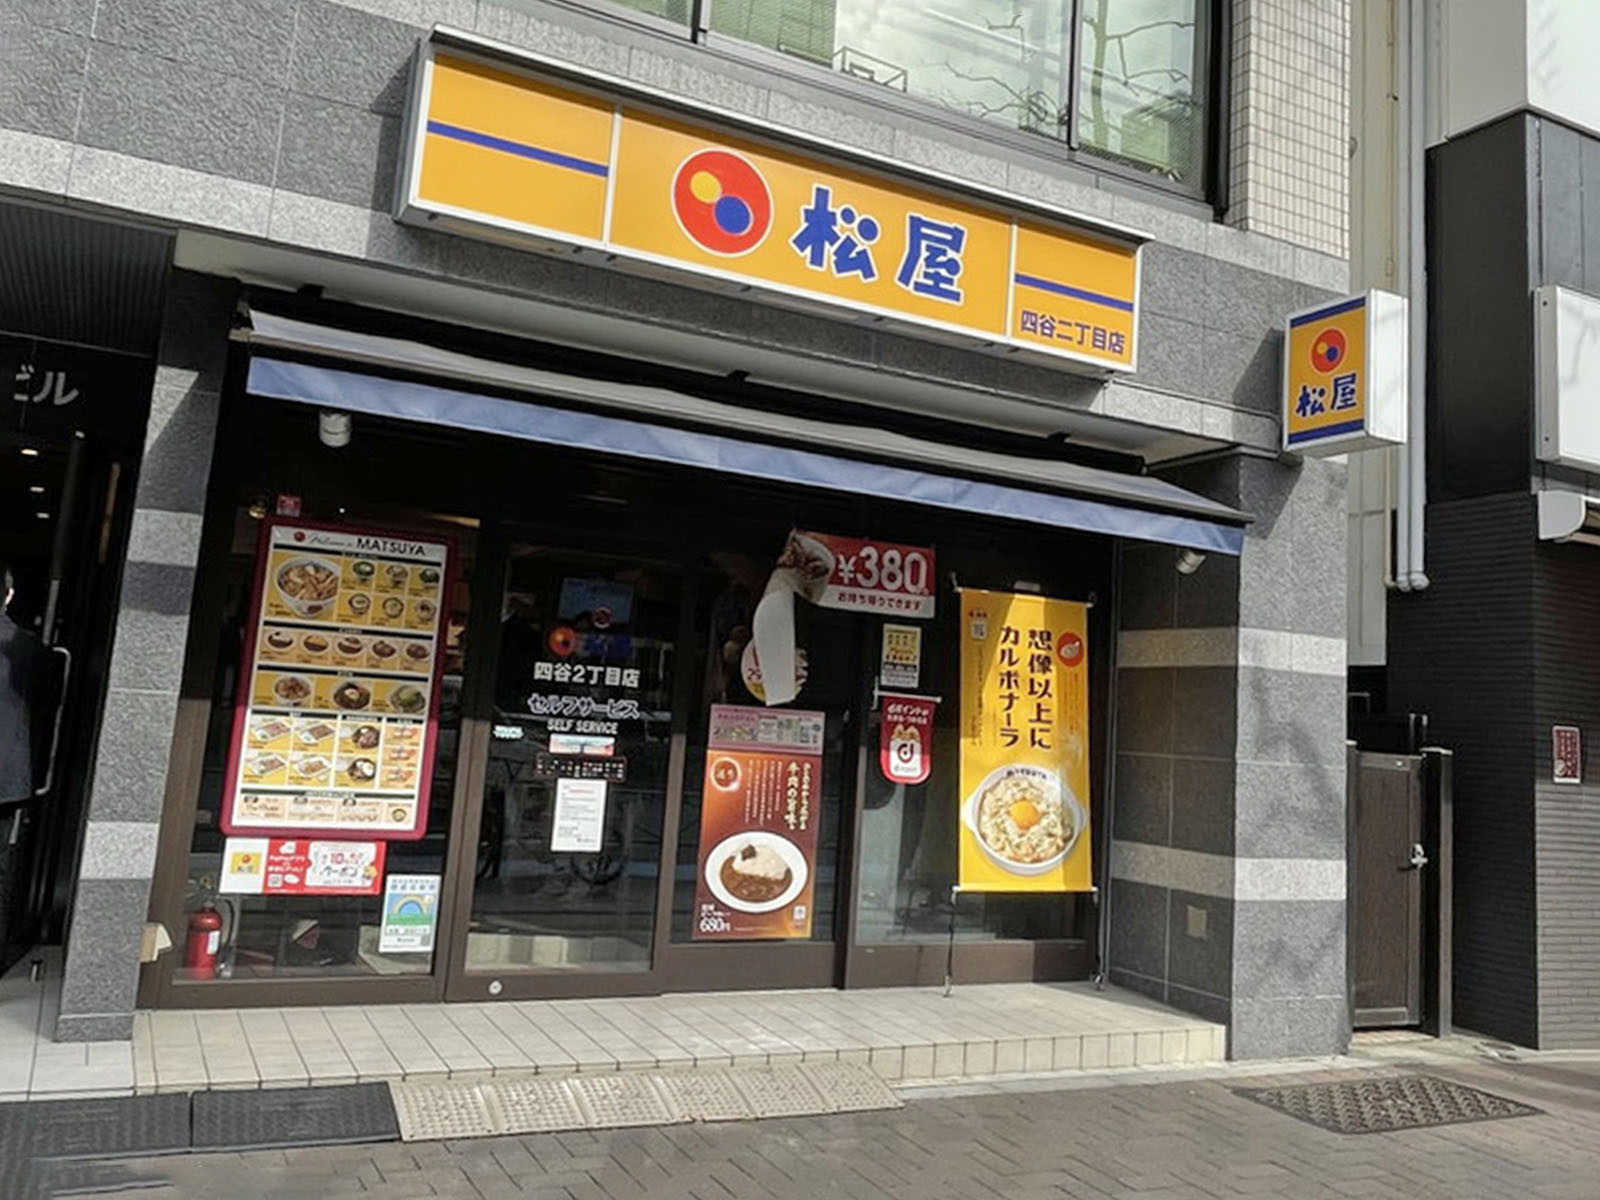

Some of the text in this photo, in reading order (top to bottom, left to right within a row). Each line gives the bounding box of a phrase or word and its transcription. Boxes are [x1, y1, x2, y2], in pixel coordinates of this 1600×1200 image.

[789, 185, 968, 306] 松屋
[1020, 309, 1126, 356] 四谷二丁目店
[1295, 372, 1358, 418] 松屋
[356, 537, 426, 556] MATSUYA
[838, 592, 922, 611] お持ち帰りできます
[533, 661, 641, 688] 四谷2丁目店
[999, 625, 1020, 747] カルボナーラ
[1027, 628, 1052, 749] 想像以上に
[527, 692, 641, 721] セルフサービス
[547, 718, 619, 735] SELF SERVICE
